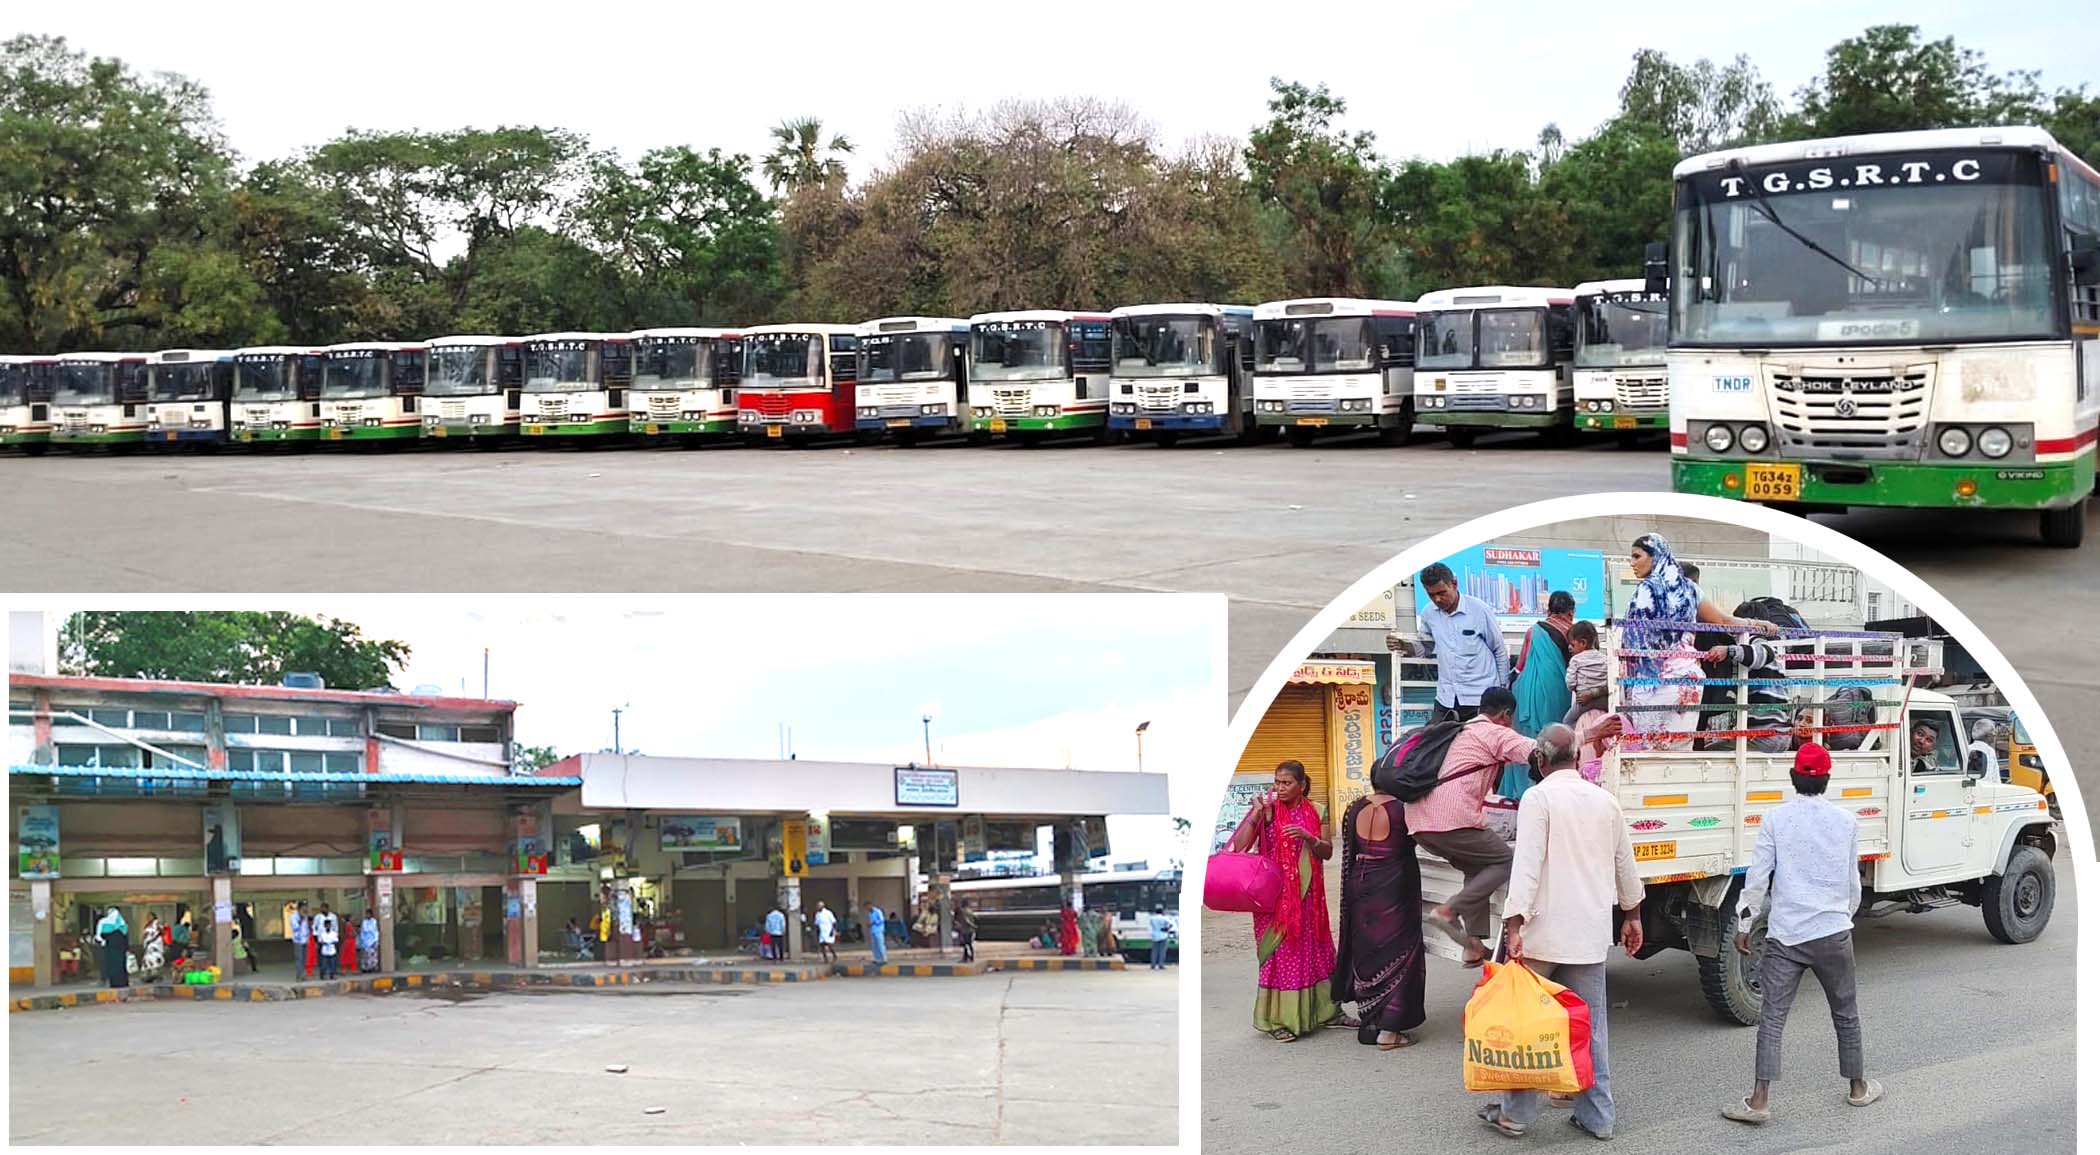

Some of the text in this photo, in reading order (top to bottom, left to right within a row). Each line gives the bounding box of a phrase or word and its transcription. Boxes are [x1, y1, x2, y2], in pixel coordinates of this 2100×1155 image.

[1716, 377, 1751, 390] TNDR
[1782, 380, 1914, 390] ASHOK LEYLAND
[1753, 483, 1792, 494] 0059
[1485, 549, 1539, 561] SUDHAKAR
[1358, 611, 1386, 622] SEEDS
[1651, 845, 1659, 856] TE
[1468, 1038, 1563, 1070] Nandini
